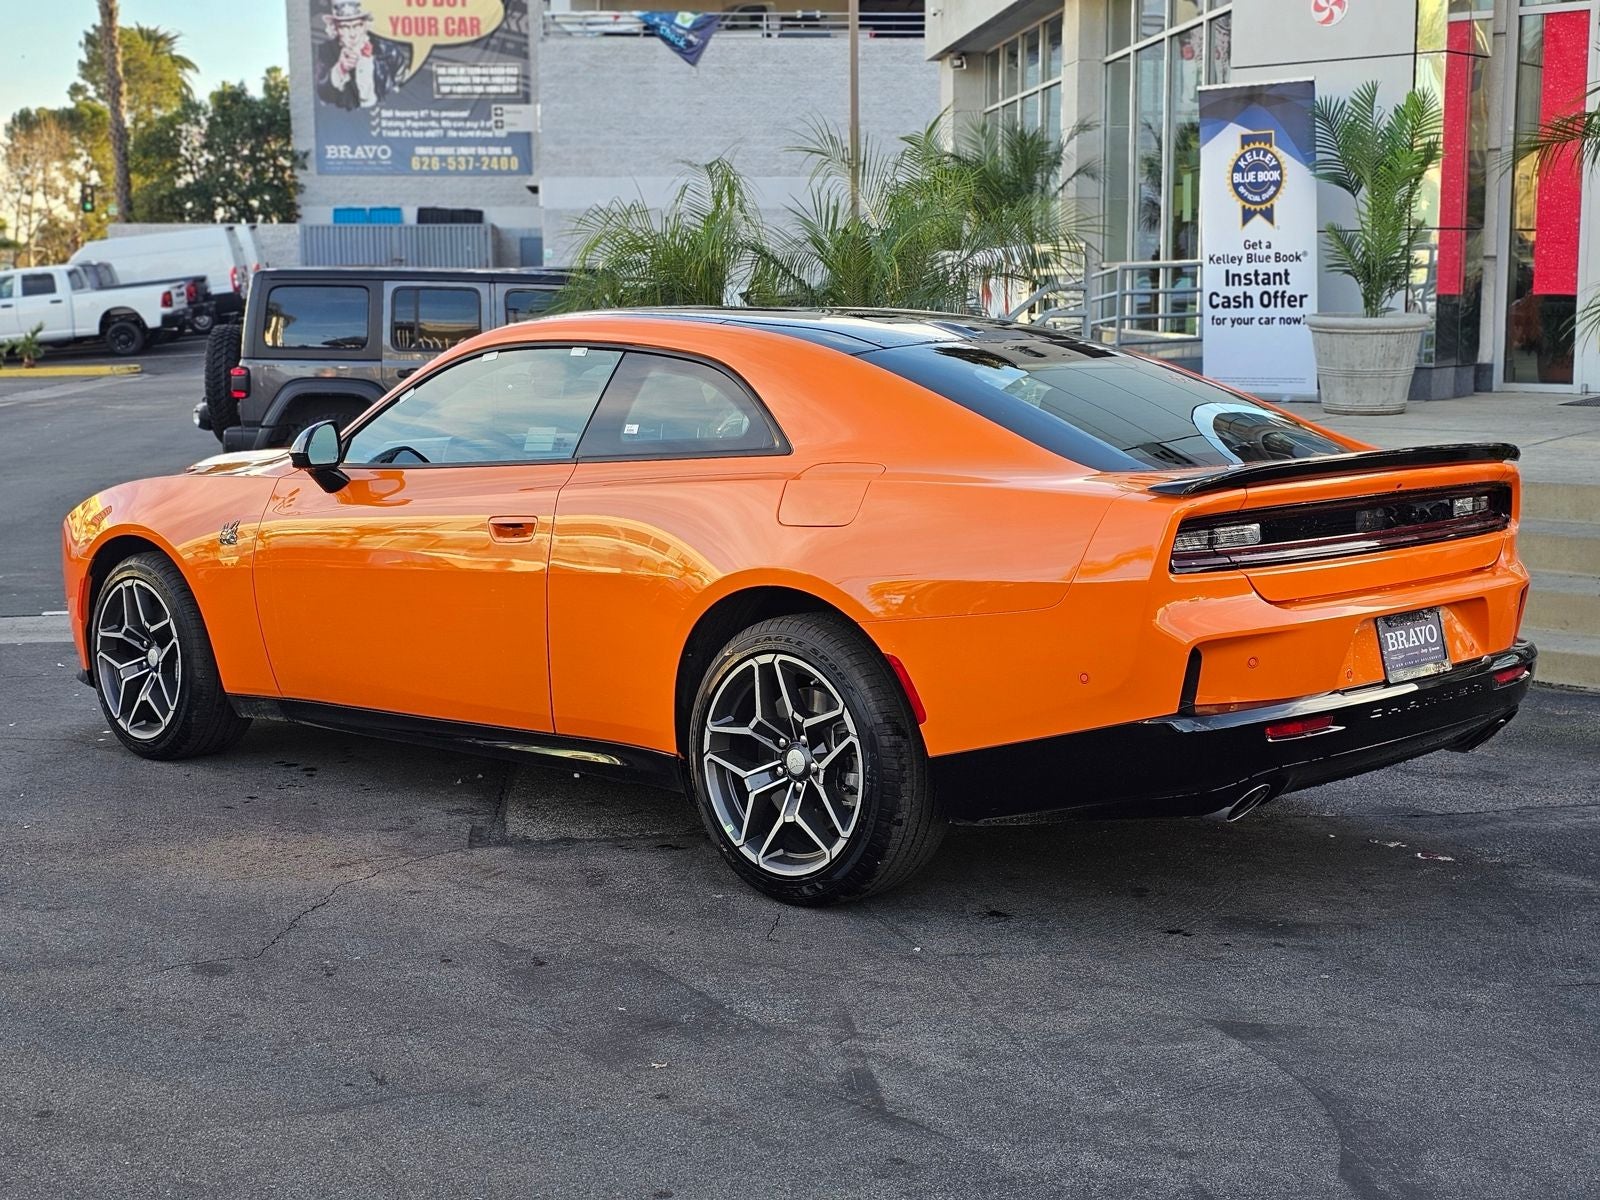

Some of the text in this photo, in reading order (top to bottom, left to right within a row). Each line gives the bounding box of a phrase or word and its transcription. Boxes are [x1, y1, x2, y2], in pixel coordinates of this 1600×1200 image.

[389, 15, 482, 37] YOUR CAR
[325, 145, 392, 159] BRAVO
[1238, 150, 1278, 168] KELLEY
[1233, 170, 1281, 183] BLUE BOOK
[1238, 185, 1262, 202] OFFICIAL
[1243, 239, 1272, 250] Get a
[1208, 253, 1243, 266] Kelley
[1246, 253, 1271, 263] Blue
[1225, 268, 1291, 287] Instant
[1208, 290, 1308, 309] Cash Offer
[1211, 314, 1306, 328] for your car now!
[1385, 624, 1438, 652] BRAVO
